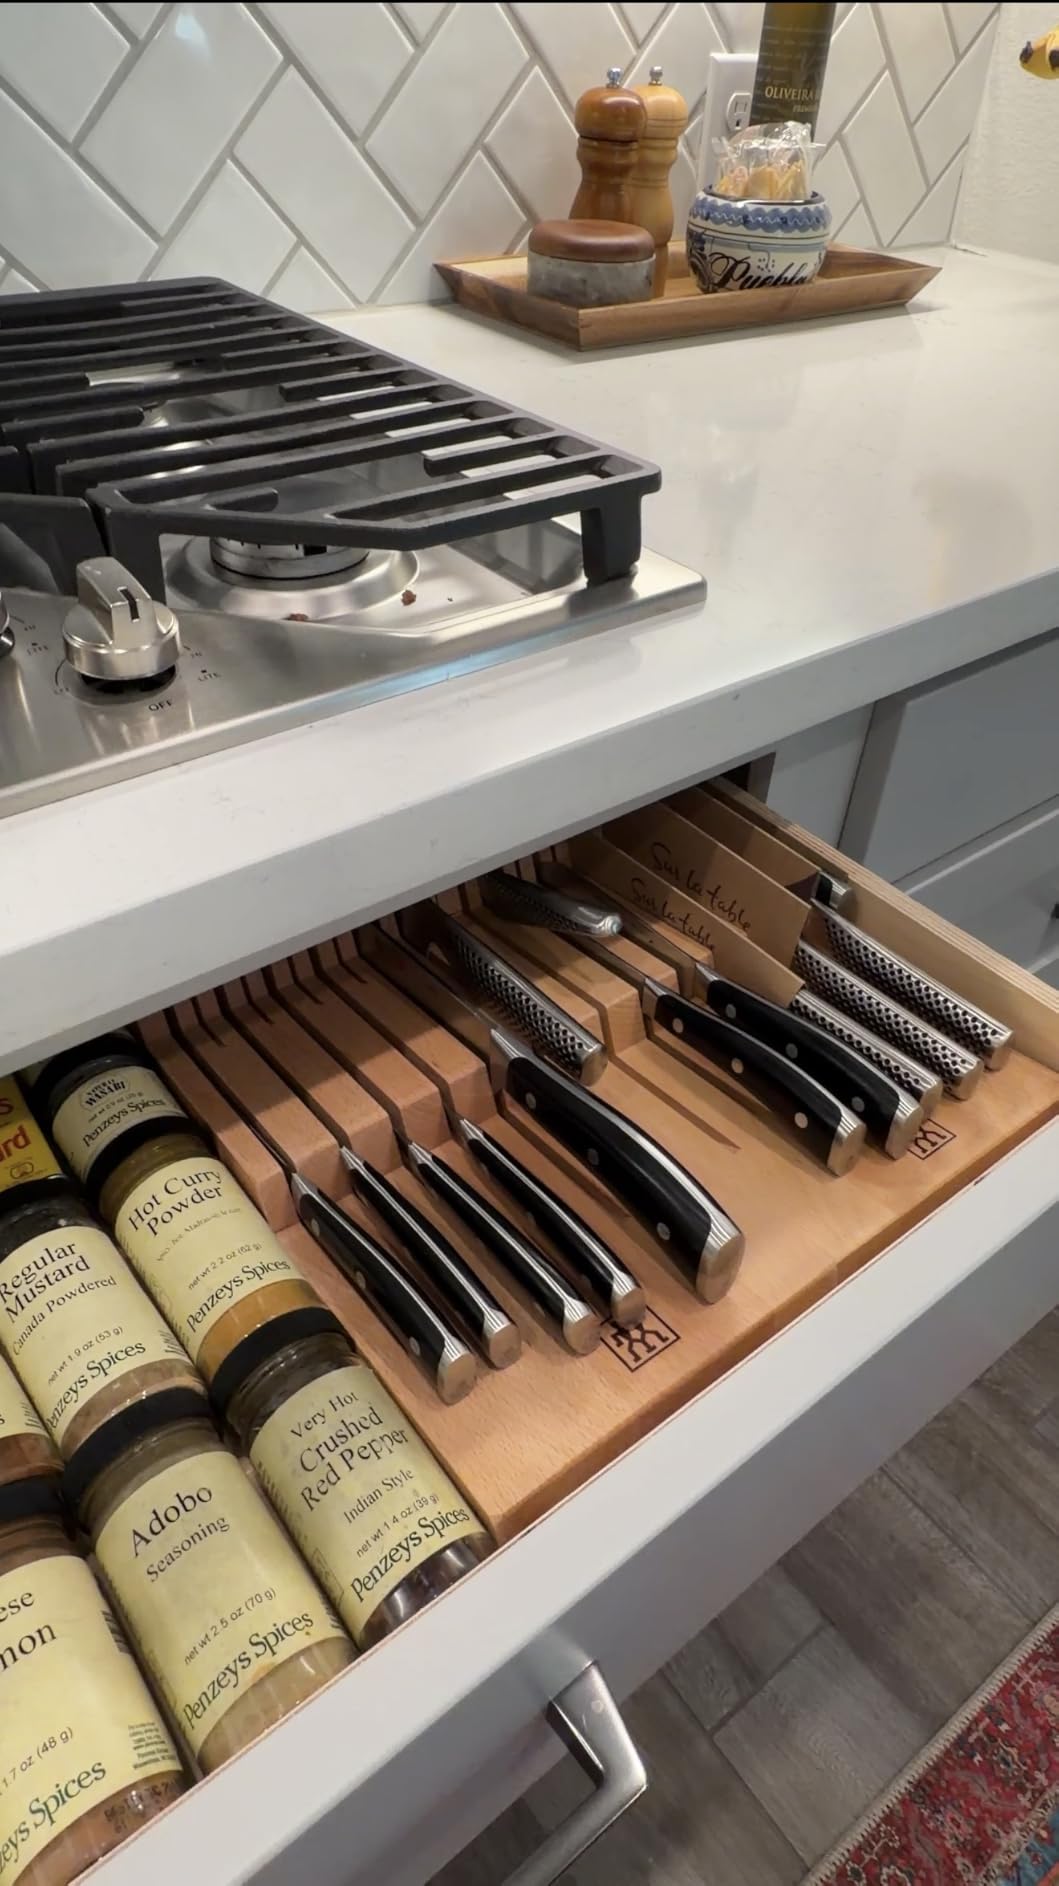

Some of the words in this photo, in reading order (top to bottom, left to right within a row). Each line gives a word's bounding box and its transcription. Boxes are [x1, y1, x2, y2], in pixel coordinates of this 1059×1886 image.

[148, 700, 173, 712] OFF
[83, 1108, 128, 1147] Penzeys
[128, 1195, 161, 1231] Hot
[164, 1171, 222, 1195] Curry
[147, 1186, 222, 1236] Powder
[0, 1243, 77, 1304] Regular
[5, 1255, 91, 1323] Mustard
[186, 1275, 244, 1332] Penzeys
[241, 1260, 291, 1281] Spices
[12, 1311, 46, 1356] Canada
[46, 1276, 118, 1313] Powdered
[83, 1340, 94, 1351] oz
[86, 1342, 146, 1380] Spices
[291, 1408, 328, 1439] Very
[328, 1391, 360, 1412] Hot
[300, 1406, 384, 1473] Crushed
[300, 1462, 342, 1512] Red
[340, 1429, 409, 1472] Pepper
[343, 1487, 383, 1524] Indian
[382, 1468, 415, 1492] Style
[131, 1486, 213, 1558] Adobo
[146, 1516, 231, 1583] Seasoning
[356, 1542, 371, 1558] net
[370, 1529, 384, 1542] wt
[400, 1506, 413, 1519] oz
[350, 1530, 422, 1602] Penzeys
[418, 1507, 470, 1539] Spices
[184, 1648, 199, 1666] net
[198, 1634, 212, 1650] wt
[229, 1606, 245, 1621] oz
[244, 1593, 263, 1612] (70
[264, 1587, 278, 1603] g)
[183, 1650, 251, 1731] Penzeys
[248, 1611, 314, 1660] Spices
[20, 1755, 34, 1772] oz
[36, 1736, 57, 1760] (48
[59, 1726, 74, 1744] g)
[28, 1761, 107, 1829] Spices
